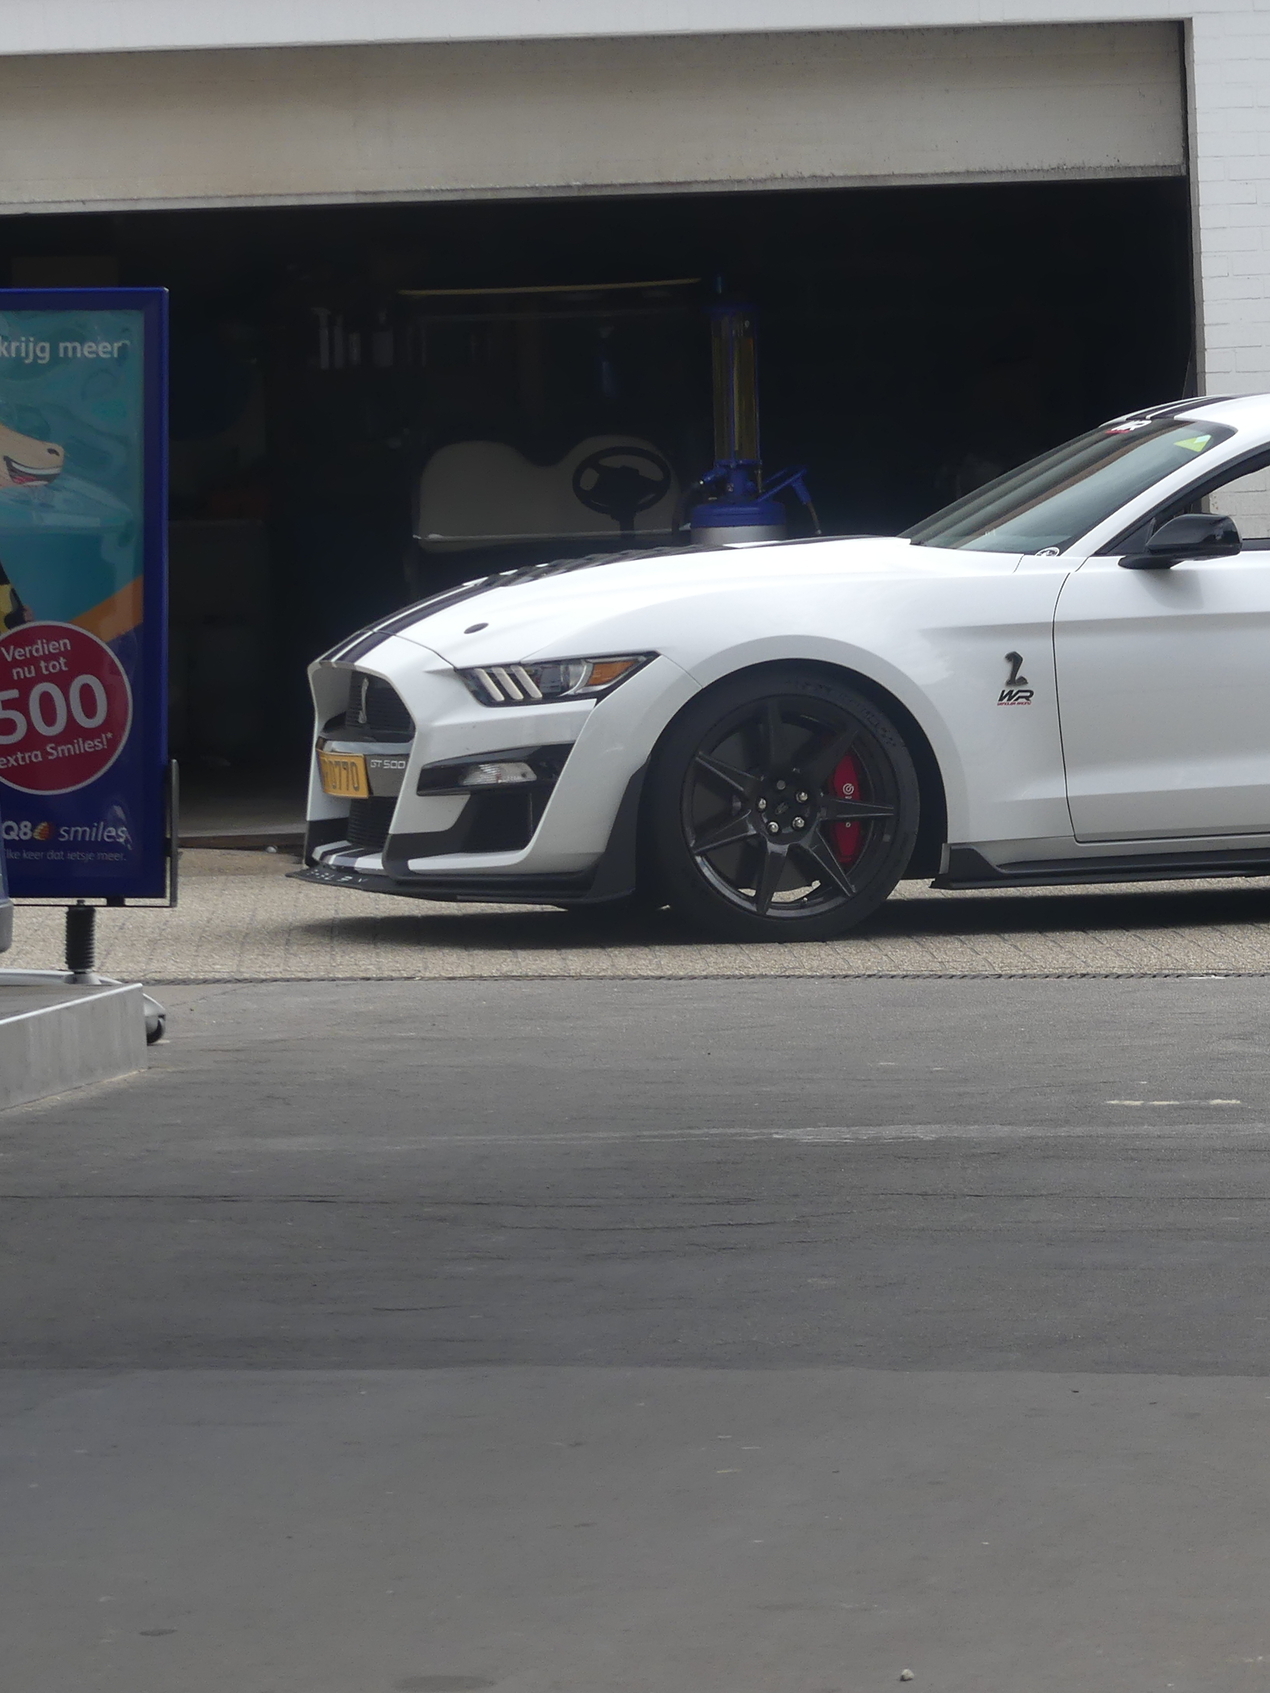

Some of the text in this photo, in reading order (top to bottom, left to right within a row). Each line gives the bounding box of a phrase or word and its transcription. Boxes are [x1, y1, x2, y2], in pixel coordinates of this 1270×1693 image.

[0, 335, 125, 364] krijg meer
[1, 638, 71, 662] Verdien
[12, 656, 69, 680] nu tot
[998, 689, 1034, 702] WR
[0, 674, 108, 745] 500
[0, 750, 43, 769] extra
[2, 820, 128, 843] Q8 smiles
[46, 850, 64, 861] dat
